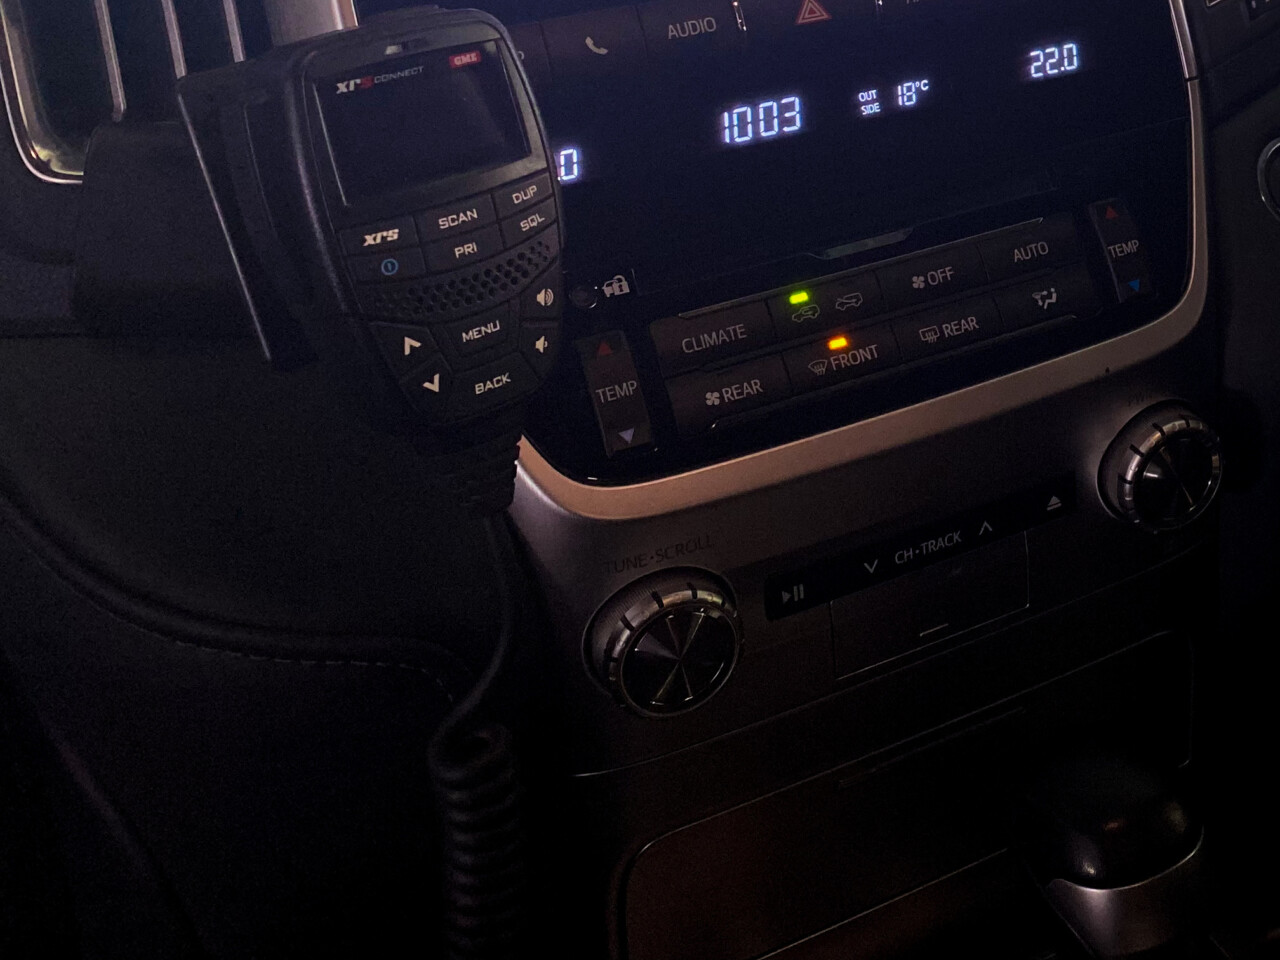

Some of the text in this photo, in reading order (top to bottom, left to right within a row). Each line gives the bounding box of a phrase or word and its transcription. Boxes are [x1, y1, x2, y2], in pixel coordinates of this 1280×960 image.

[667, 16, 717, 40] AUDIO
[453, 52, 478, 66] GME
[1029, 43, 1078, 78] 22.0
[374, 65, 424, 84] CONNECT
[858, 89, 878, 102] OUT
[861, 102, 881, 115] SIDE
[512, 184, 538, 204] DUP
[438, 208, 478, 230] SCAN
[520, 212, 546, 232] SQL
[454, 242, 478, 259] PRI
[1013, 241, 1049, 263] AUTO
[1107, 239, 1140, 259] TEMP
[926, 266, 954, 287] OFF
[461, 320, 501, 343] MENU
[942, 315, 979, 338] REAR
[681, 323, 748, 354] CLIMATE
[830, 344, 879, 371] FRONT
[474, 372, 512, 395] BACK
[595, 380, 638, 404] TEMP
[721, 379, 763, 404] REAR
